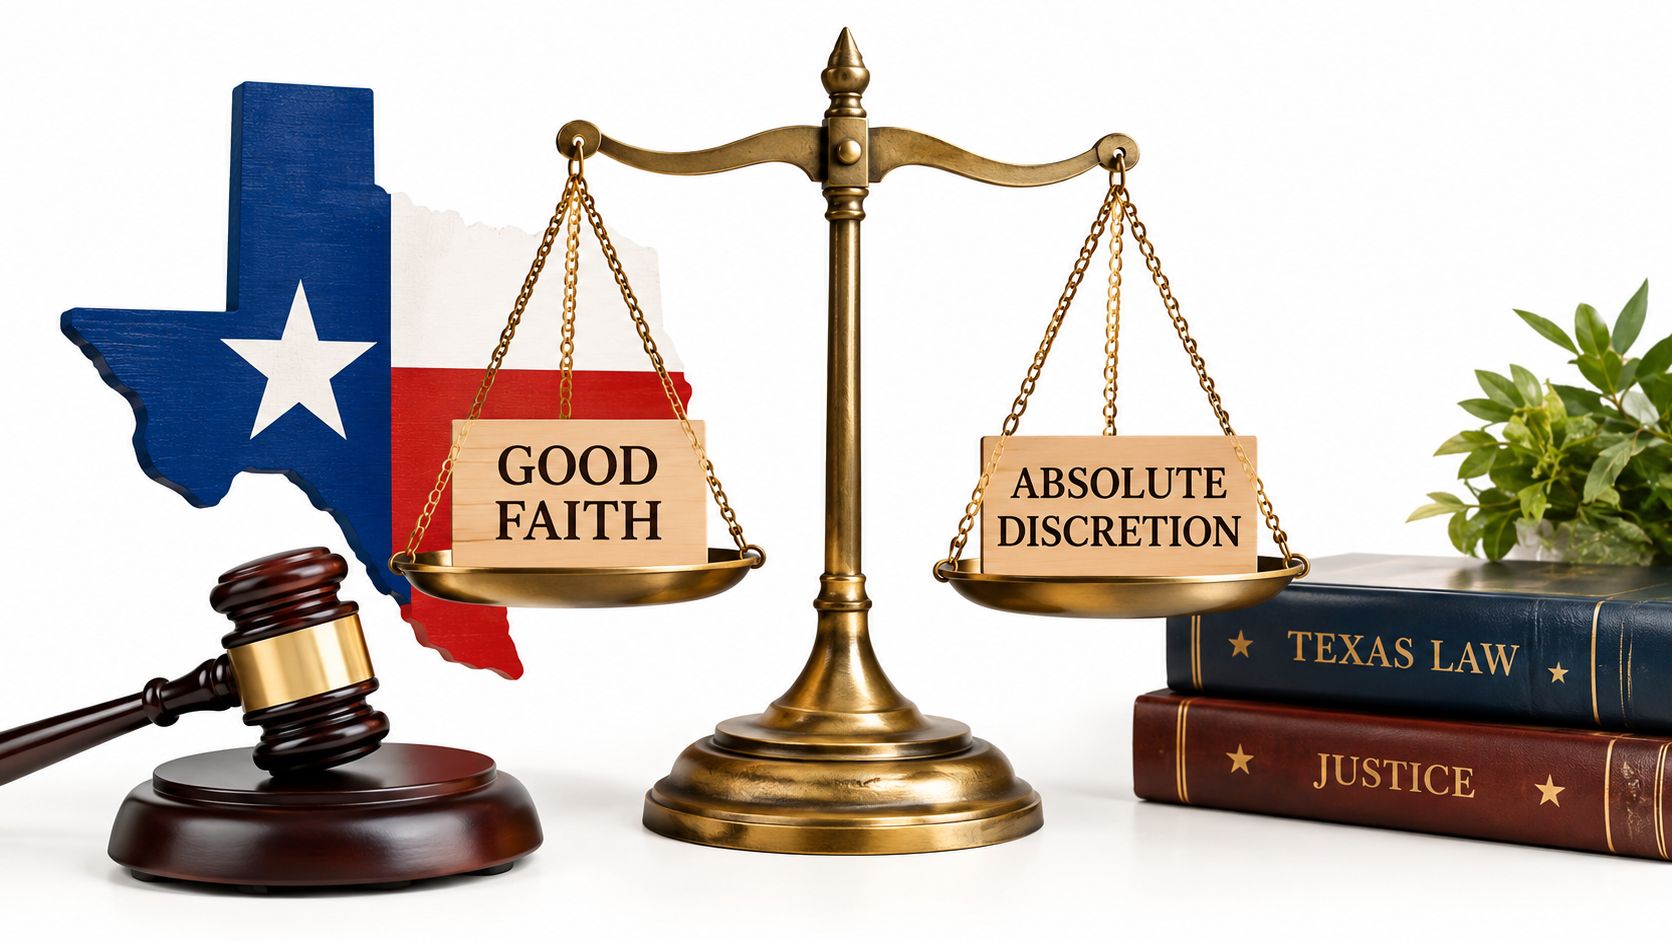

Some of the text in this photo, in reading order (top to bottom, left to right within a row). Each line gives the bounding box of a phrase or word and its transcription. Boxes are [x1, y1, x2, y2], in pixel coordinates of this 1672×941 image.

[497, 444, 658, 486] GOOD
[1010, 466, 1228, 500] ABSOLUTE
[495, 499, 662, 541] FAITH
[997, 515, 1242, 548] DISCRETION
[1287, 630, 1520, 677] TEXAS LAW
[1312, 752, 1476, 799] JUSTICE
